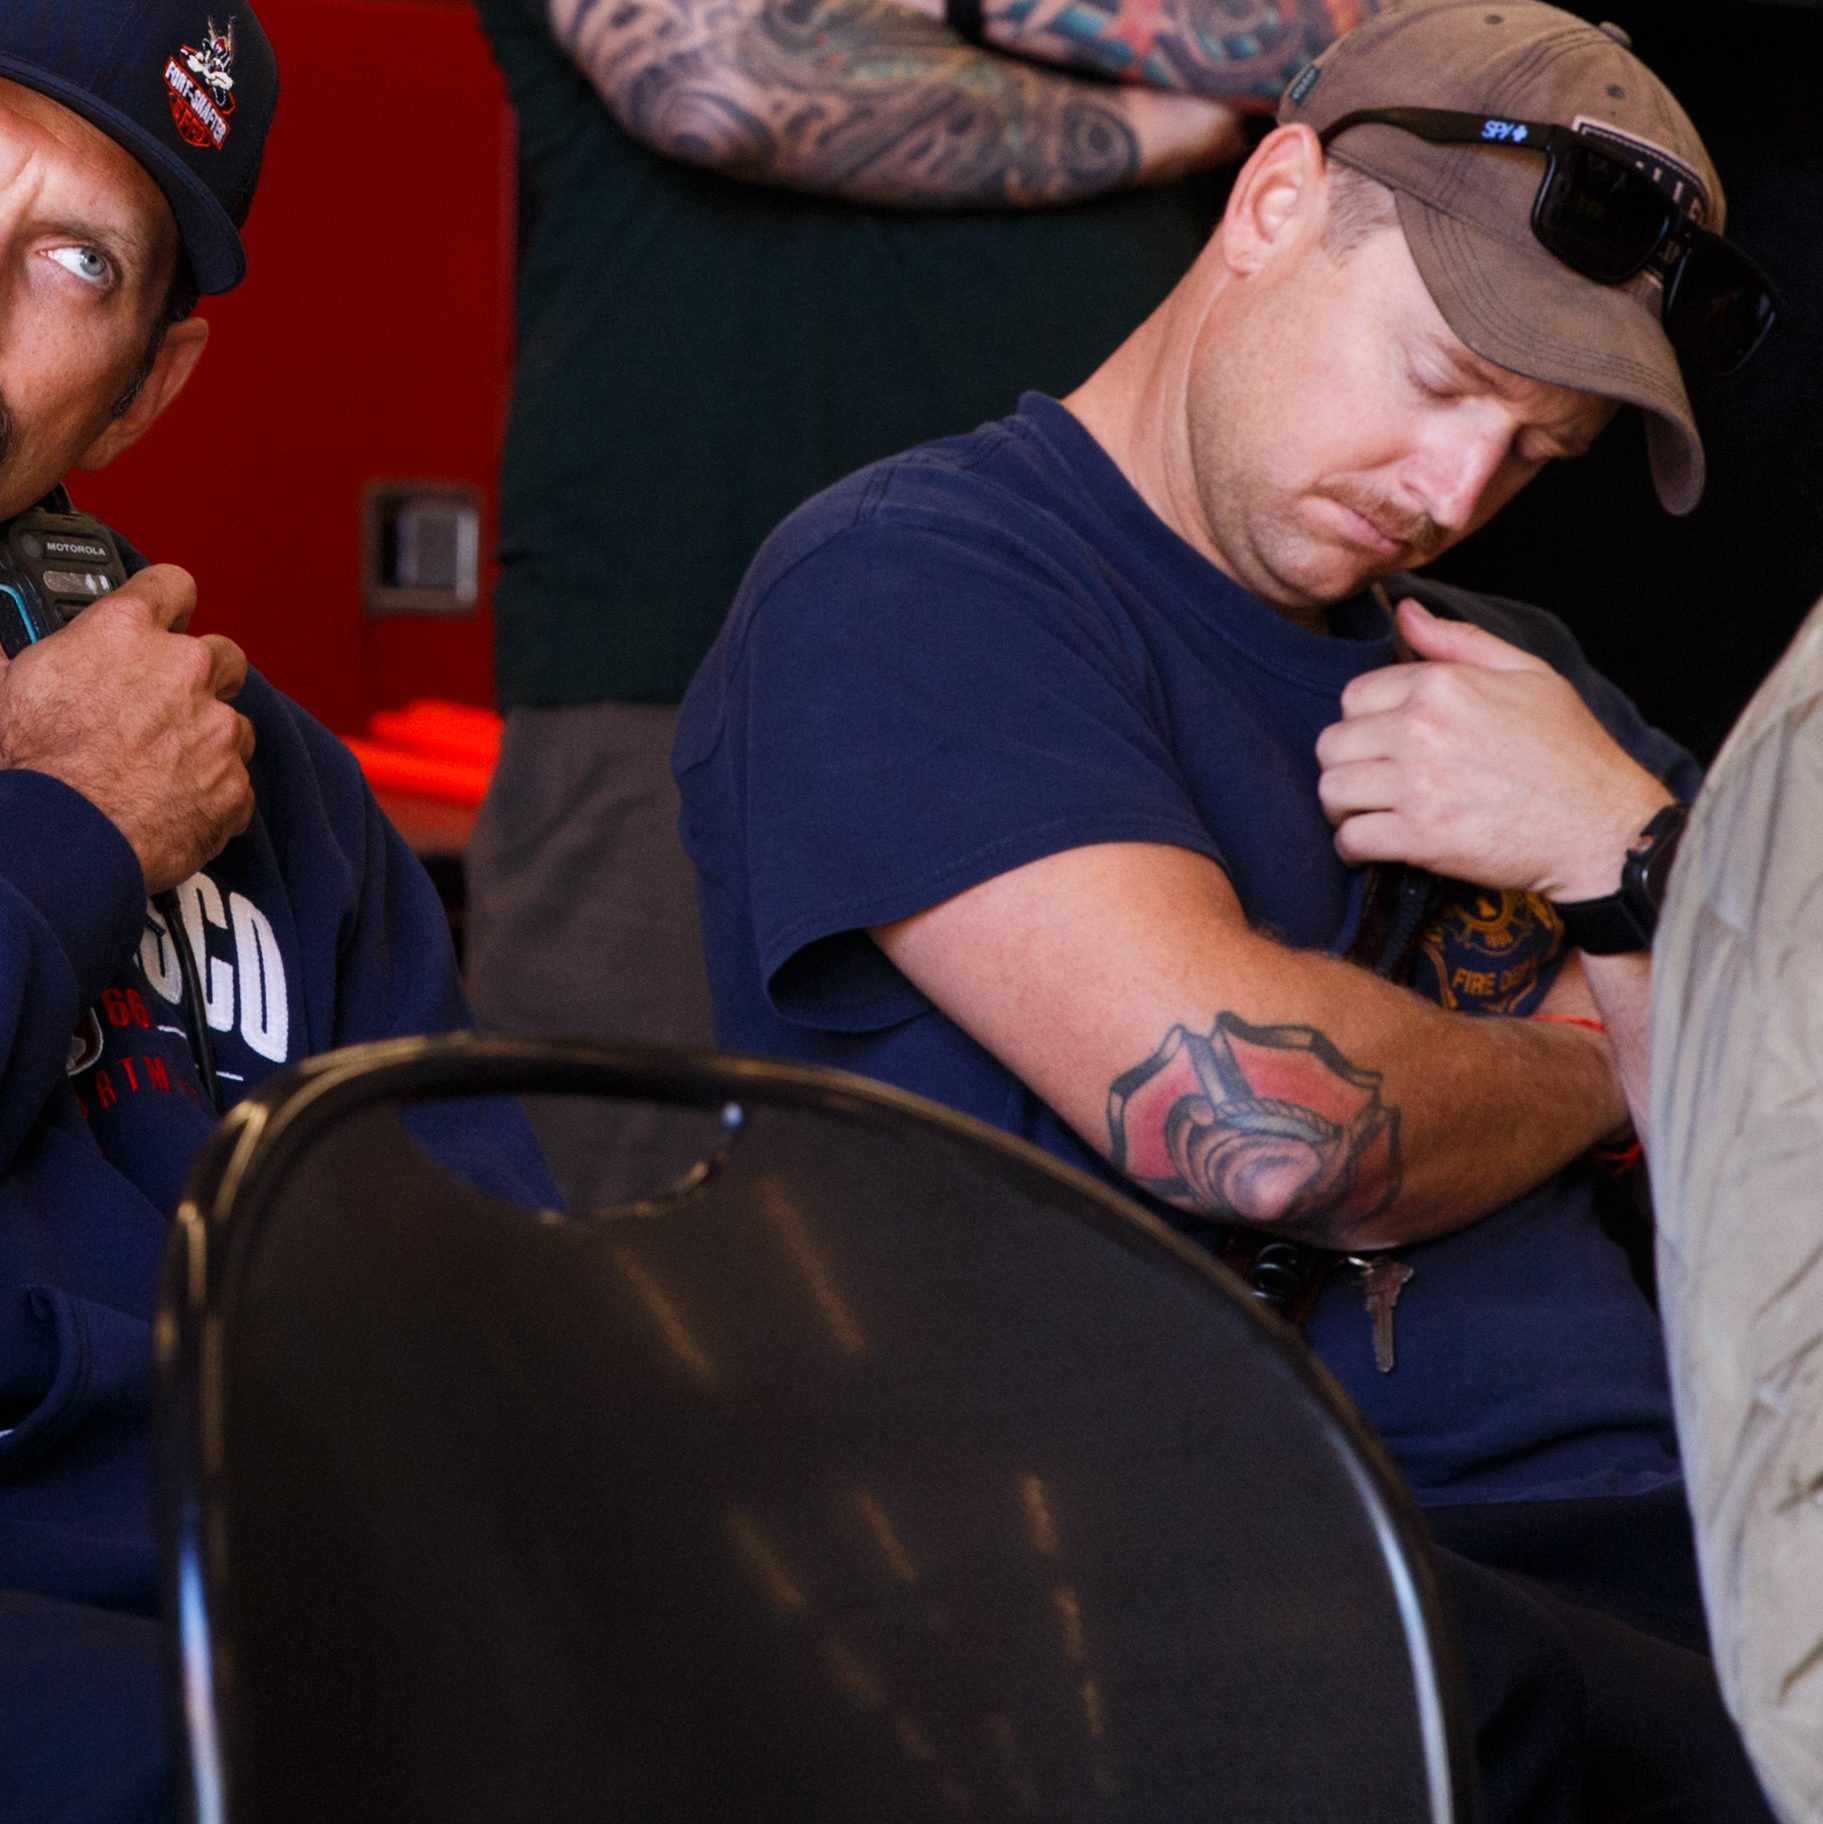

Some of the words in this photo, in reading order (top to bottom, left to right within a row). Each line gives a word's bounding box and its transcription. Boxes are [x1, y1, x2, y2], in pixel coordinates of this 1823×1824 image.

[1480, 119, 1513, 141] SPY
[47, 542, 106, 557] MOTOROLA
[1452, 967, 1497, 997] FIRE
[100, 987, 152, 1029] 66
